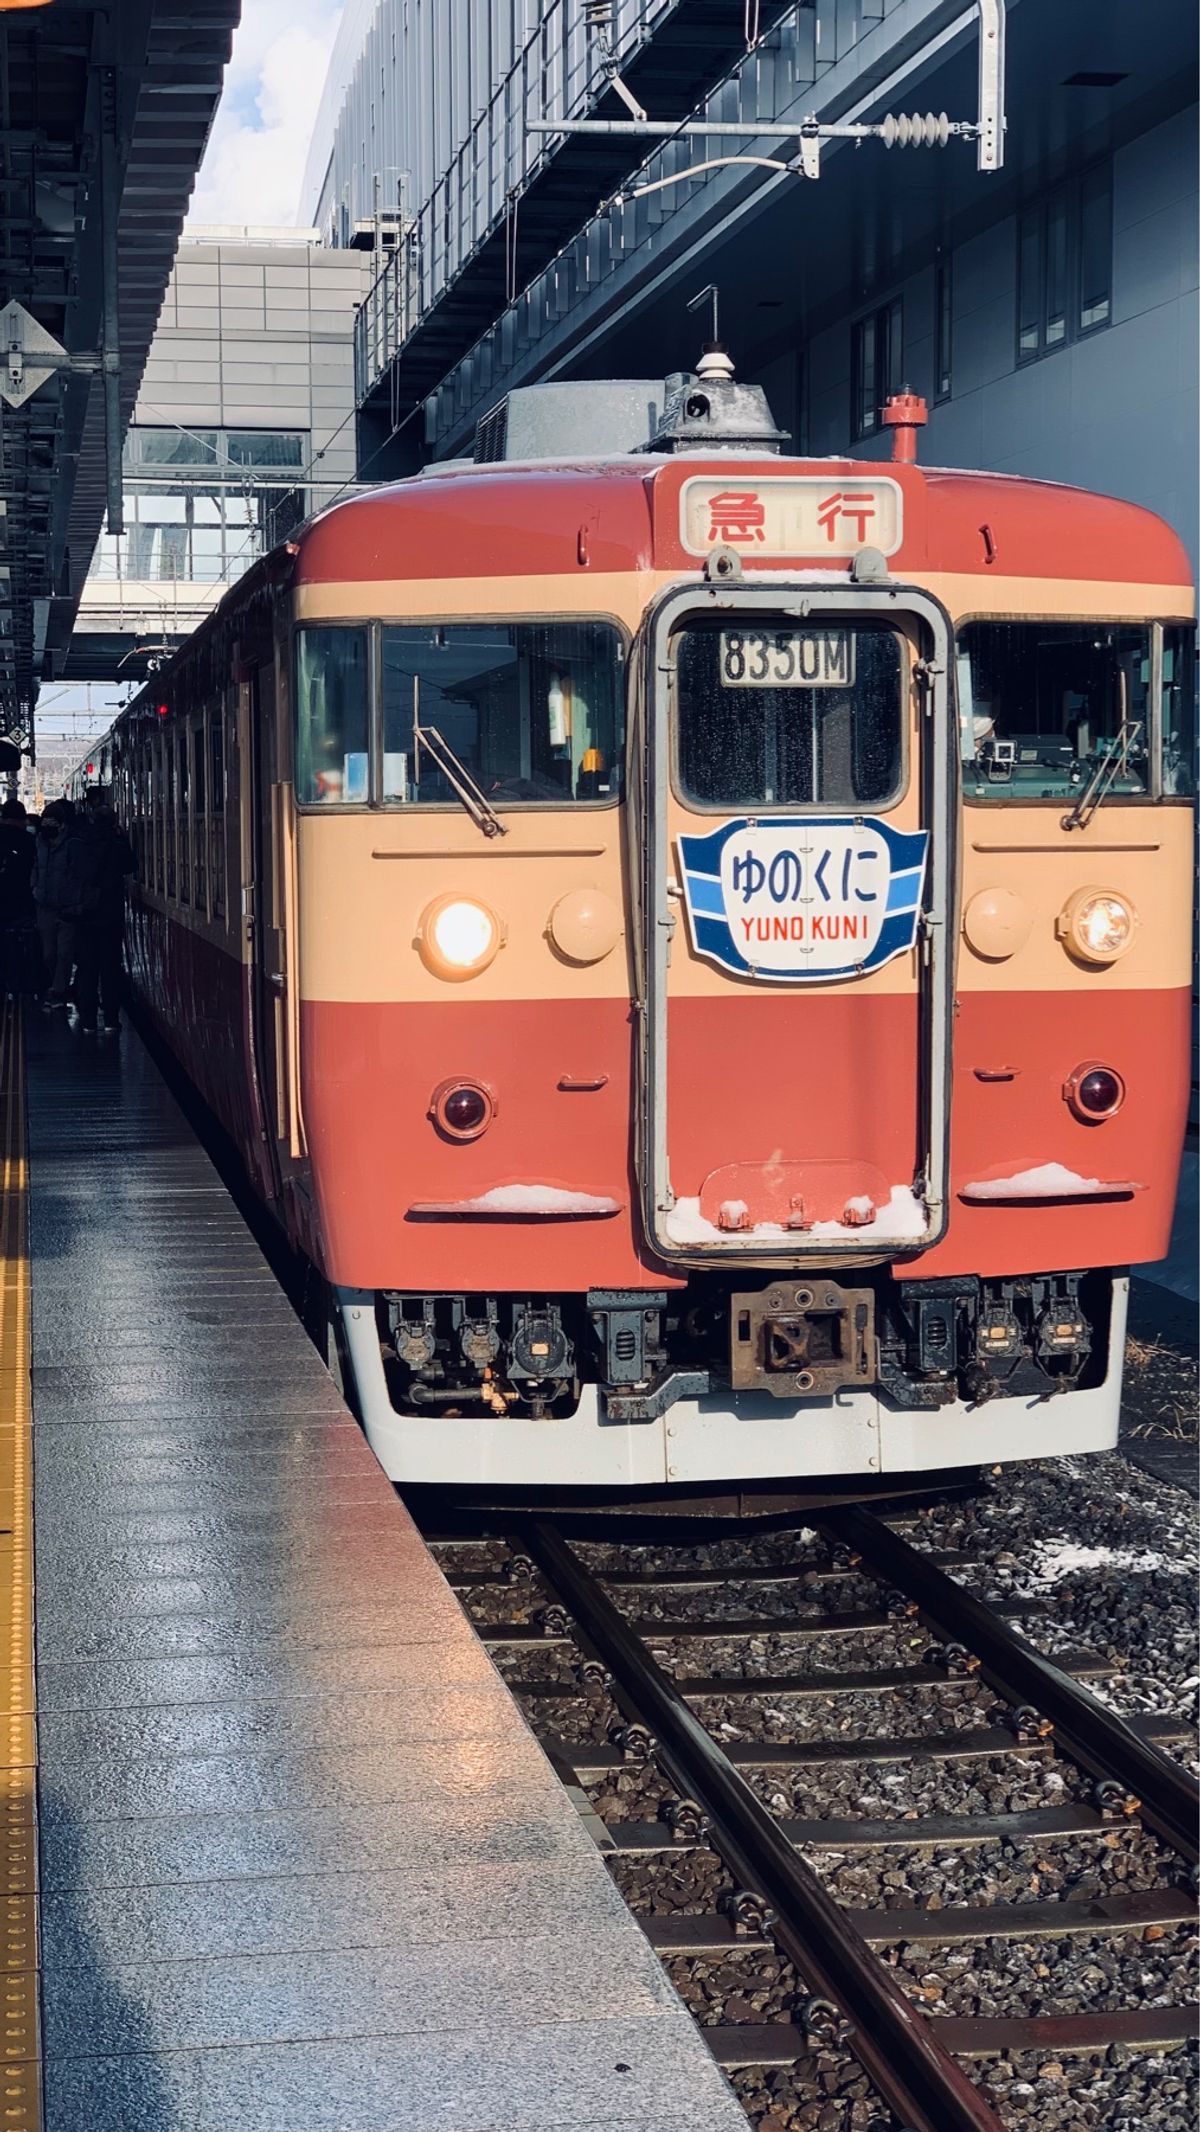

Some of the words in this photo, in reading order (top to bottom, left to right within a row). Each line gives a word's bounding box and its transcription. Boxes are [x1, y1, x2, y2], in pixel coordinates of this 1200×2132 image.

[708, 492, 876, 543] 急行
[725, 632, 845, 680] 8350M
[733, 848, 878, 904] ゆのくに
[740, 916, 804, 942] YUNO
[812, 915, 868, 940] KUNI
